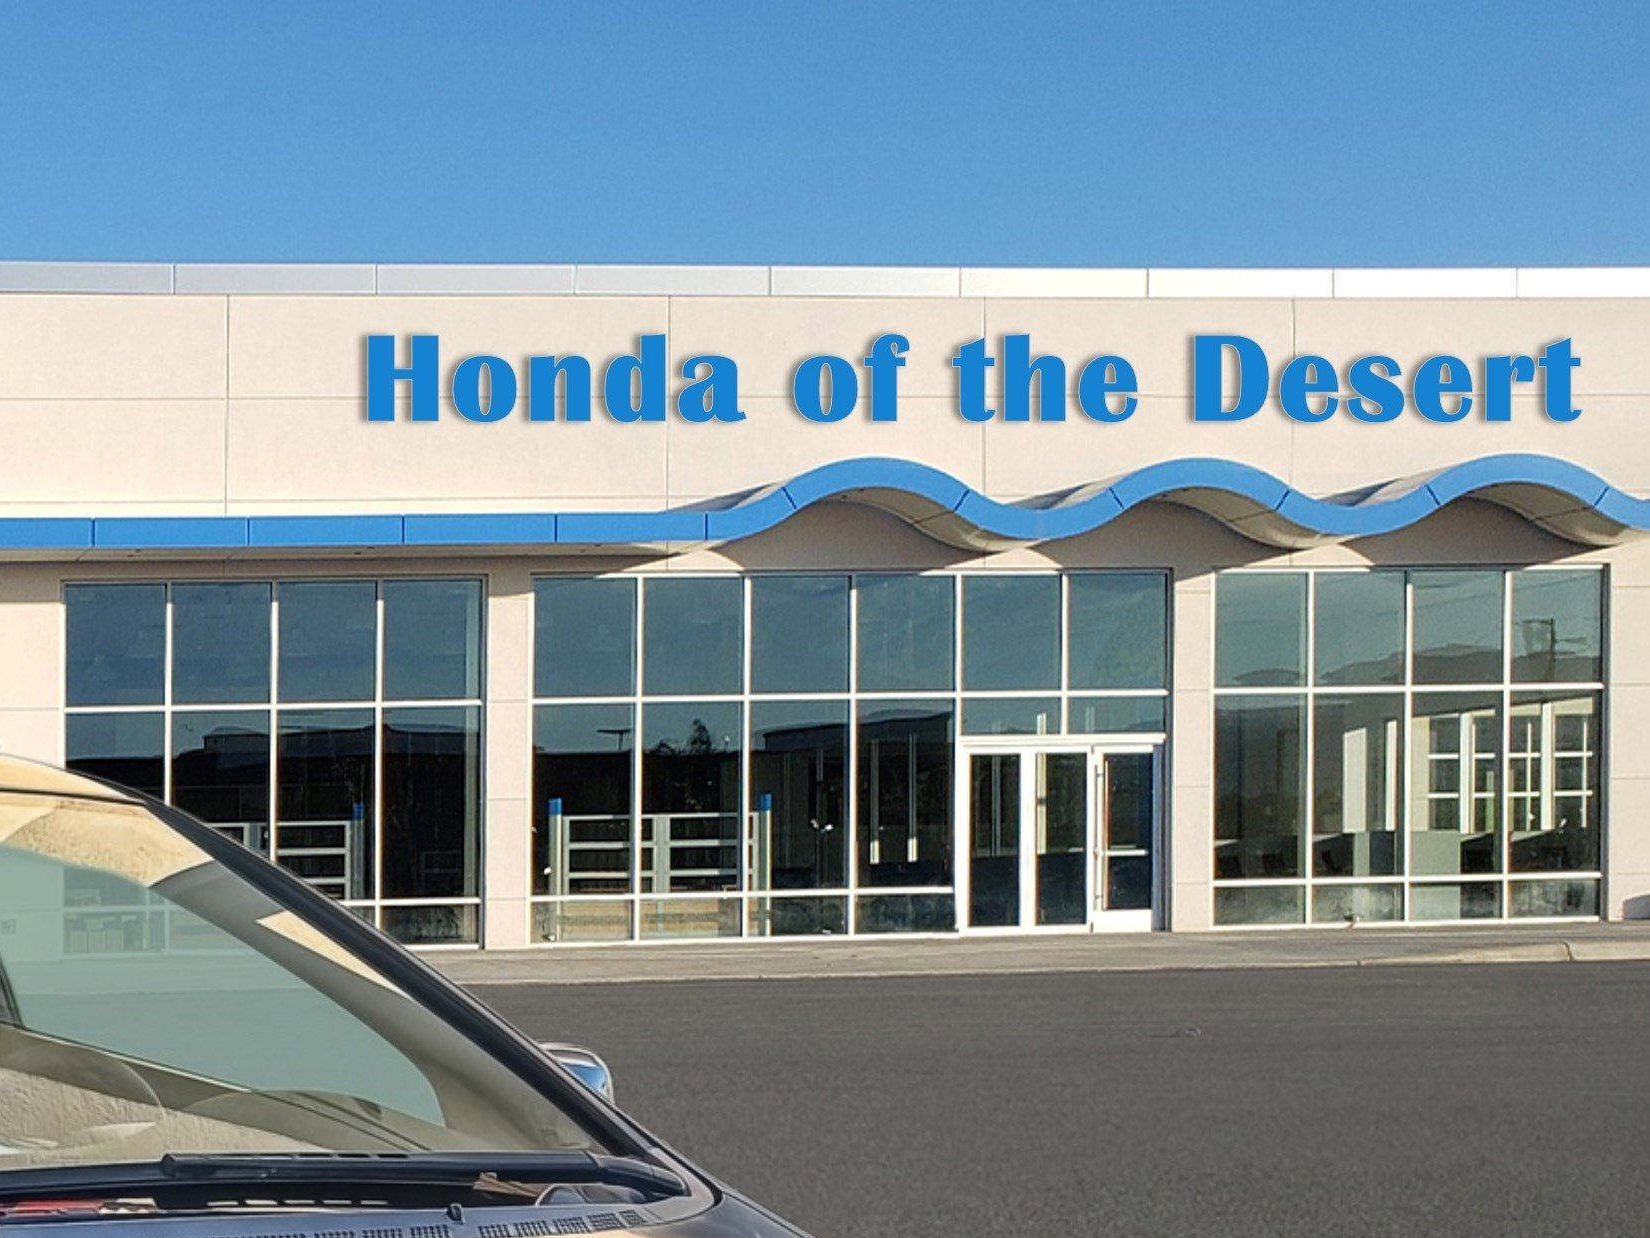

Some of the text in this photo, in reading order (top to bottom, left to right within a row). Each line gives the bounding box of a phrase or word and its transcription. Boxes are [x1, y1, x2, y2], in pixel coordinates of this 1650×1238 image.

[366, 332, 1583, 423] Honda of the Desert
